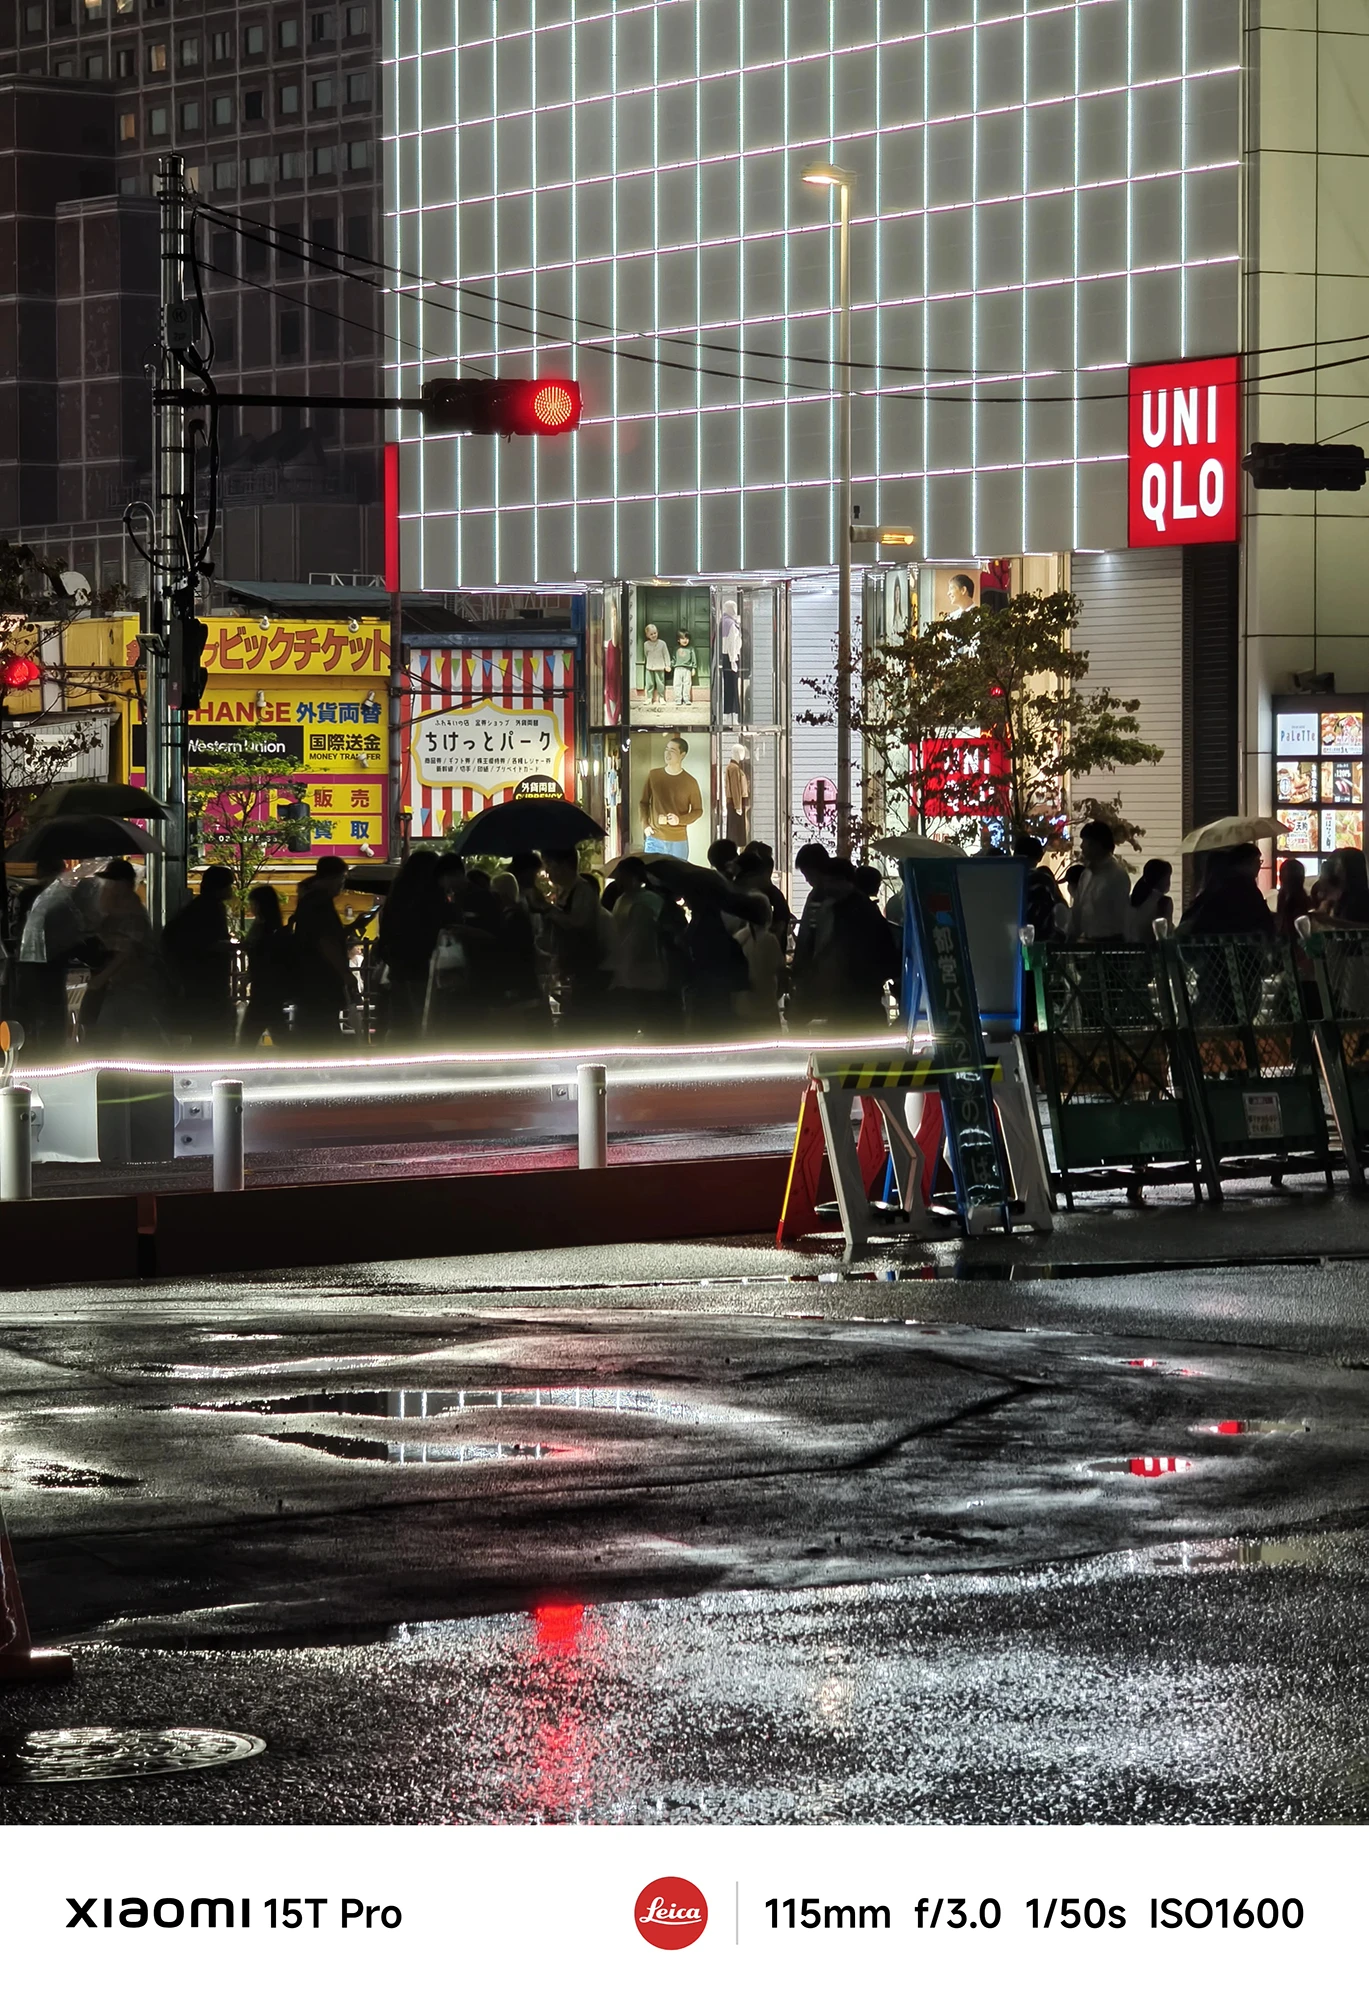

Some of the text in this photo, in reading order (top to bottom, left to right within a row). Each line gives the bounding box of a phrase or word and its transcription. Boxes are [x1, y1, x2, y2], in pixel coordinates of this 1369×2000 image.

[1143, 386, 1216, 447] UNI
[1143, 459, 1223, 531] QLO
[297, 701, 382, 724] 外貨両替
[309, 734, 381, 751] 国際送金
[425, 730, 551, 752] ちけっとパーク
[314, 789, 370, 808] 販売
